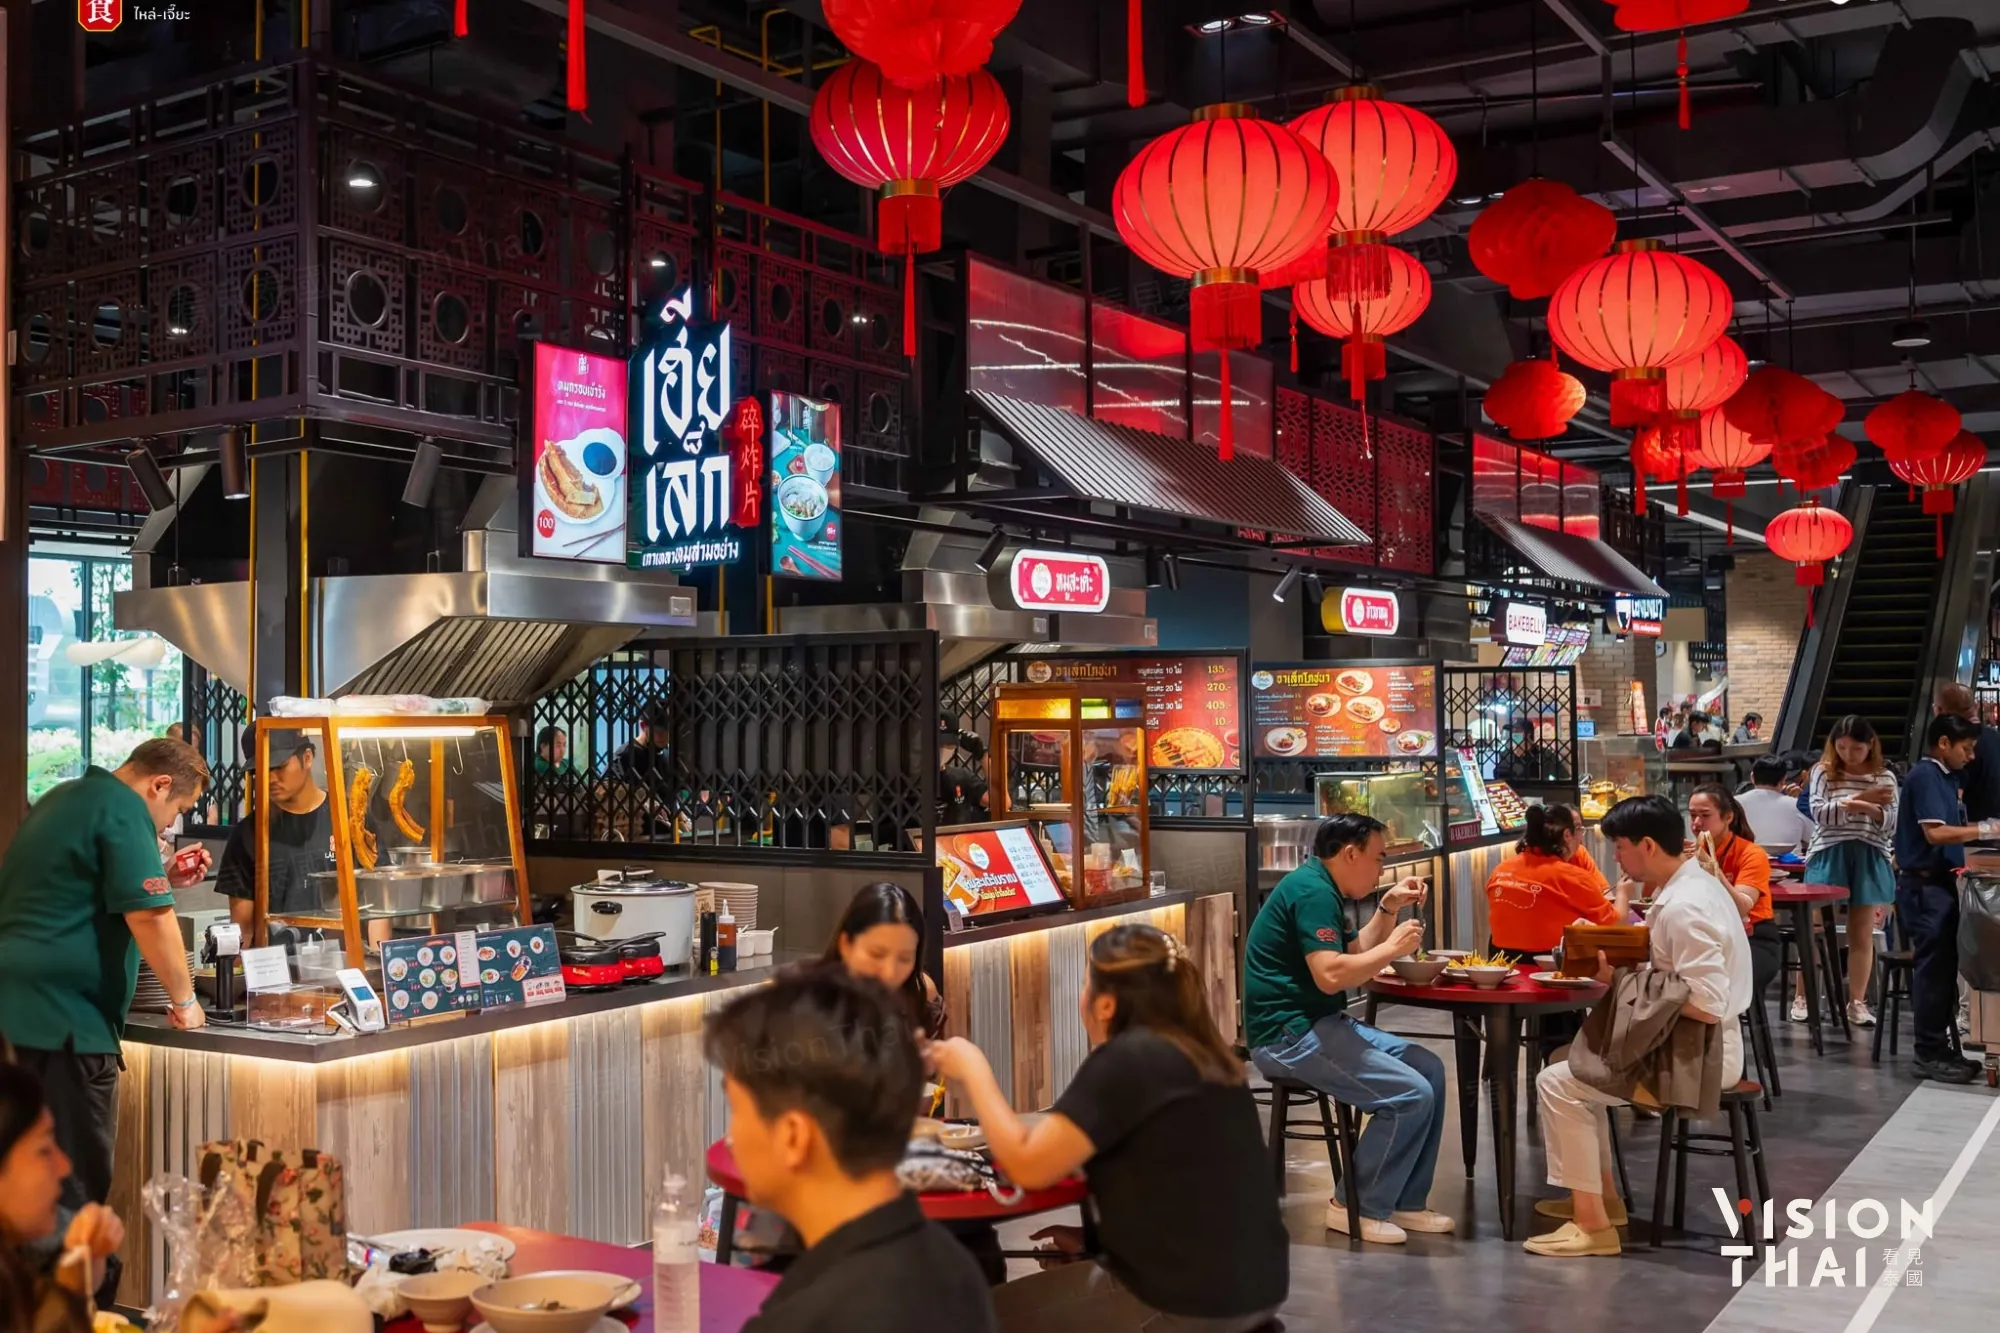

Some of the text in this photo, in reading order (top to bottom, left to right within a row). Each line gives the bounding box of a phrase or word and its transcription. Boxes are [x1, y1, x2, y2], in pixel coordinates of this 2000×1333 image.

[134, 4, 191, 20] ไหล่-เจี๊ยะ
[643, 287, 731, 456] เฮีย
[645, 421, 730, 543] เล็ก
[539, 516, 554, 529] 100
[642, 536, 739, 571] เกาเหลาหมูสามอย่าง
[1056, 567, 1094, 601] หมูสะเต๊ะ
[1508, 614, 1546, 634] BAKEBELLY
[1207, 664, 1232, 674] 135.-
[1146, 681, 1164, 692] สะเต๊ะ
[1206, 683, 1232, 692] 270.-
[1146, 698, 1164, 710] สะเต๊ะ
[1206, 701, 1232, 710] 405.-
[1214, 717, 1232, 726] 10.-
